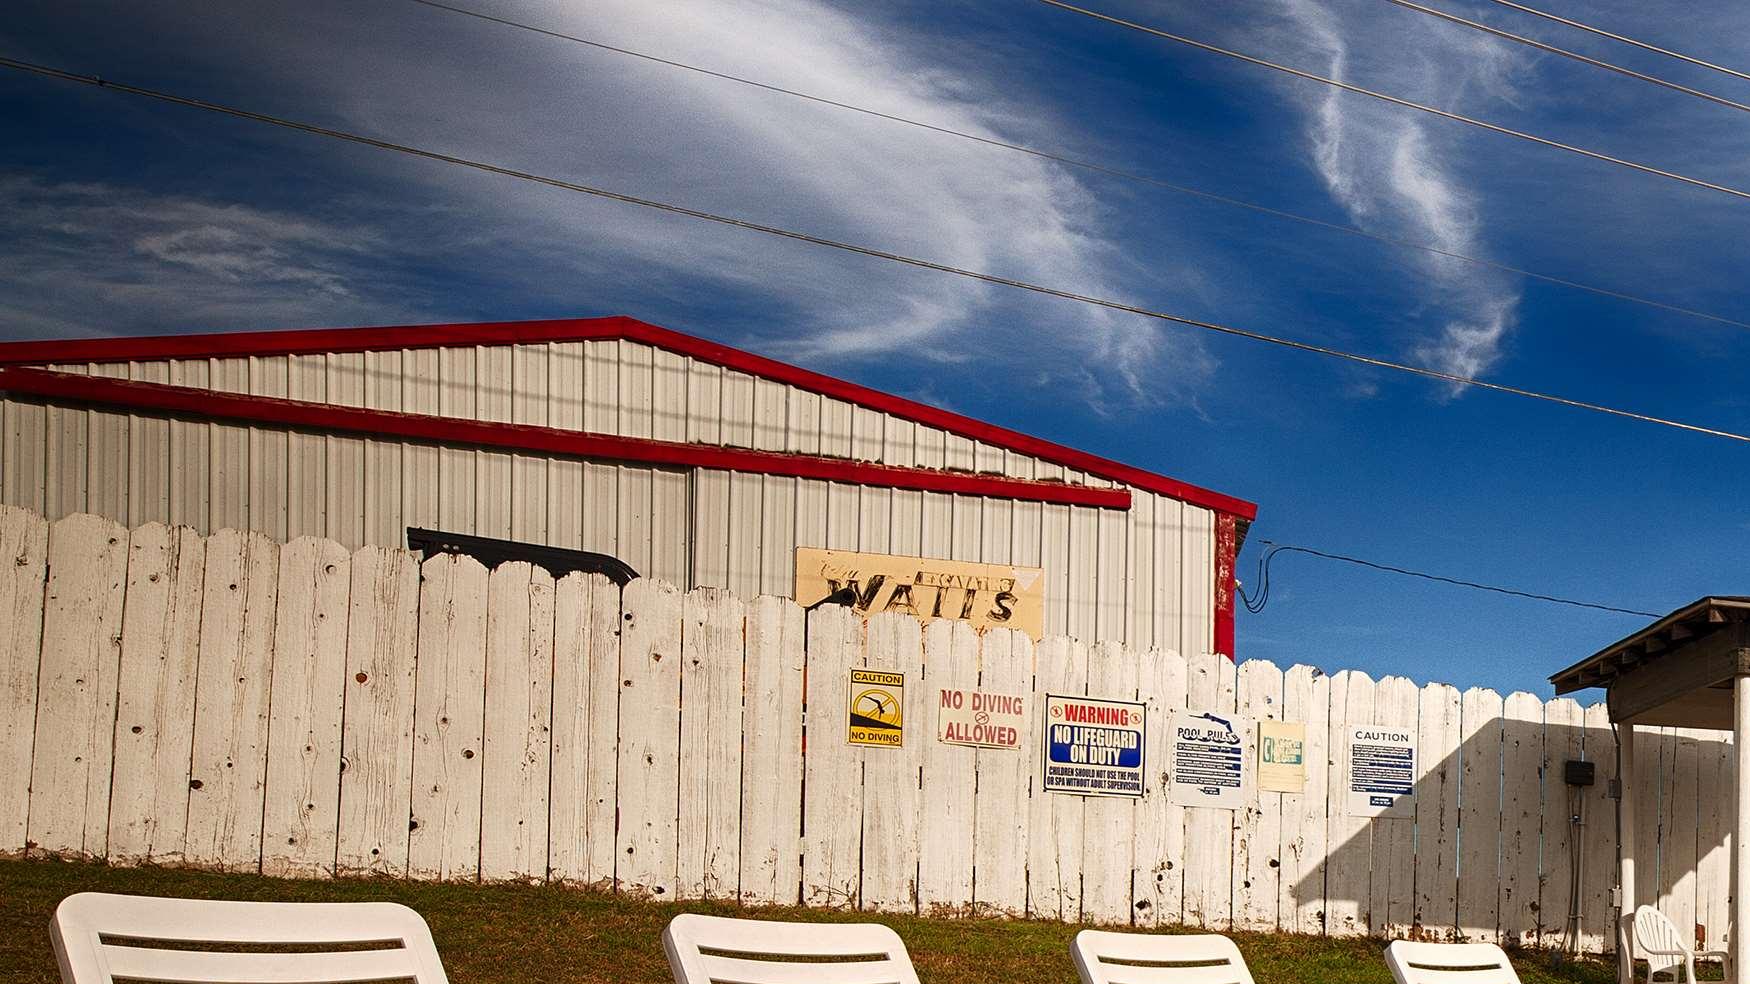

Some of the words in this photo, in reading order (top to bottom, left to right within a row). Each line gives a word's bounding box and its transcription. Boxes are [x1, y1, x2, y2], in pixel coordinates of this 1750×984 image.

[853, 672, 901, 684] CAUTION
[941, 690, 963, 709] NO
[972, 693, 1023, 715] DIVING
[1064, 703, 1129, 727] WARNING
[851, 732, 865, 740] NO
[868, 733, 899, 742] DIVING
[945, 721, 1017, 745] ALLOWED
[1054, 725, 1072, 744] NO
[1073, 726, 1137, 749] LIFEGUARD
[1177, 727, 1200, 737] POOL
[1355, 731, 1409, 742] CAUTION
[1070, 744, 1088, 763] ON
[1089, 746, 1121, 766] DUTY
[1048, 766, 1074, 776] CHILDREN
[1075, 768, 1095, 778] SHOULD
[1096, 769, 1106, 779] NOT
[1107, 770, 1117, 780] USE
[1117, 771, 1127, 781] THE
[1127, 772, 1140, 782] POOL
[1046, 776, 1054, 786] OR
[1055, 776, 1065, 786] SPA
[1065, 777, 1090, 787] WITHOUT
[1090, 779, 1106, 789] ADULT
